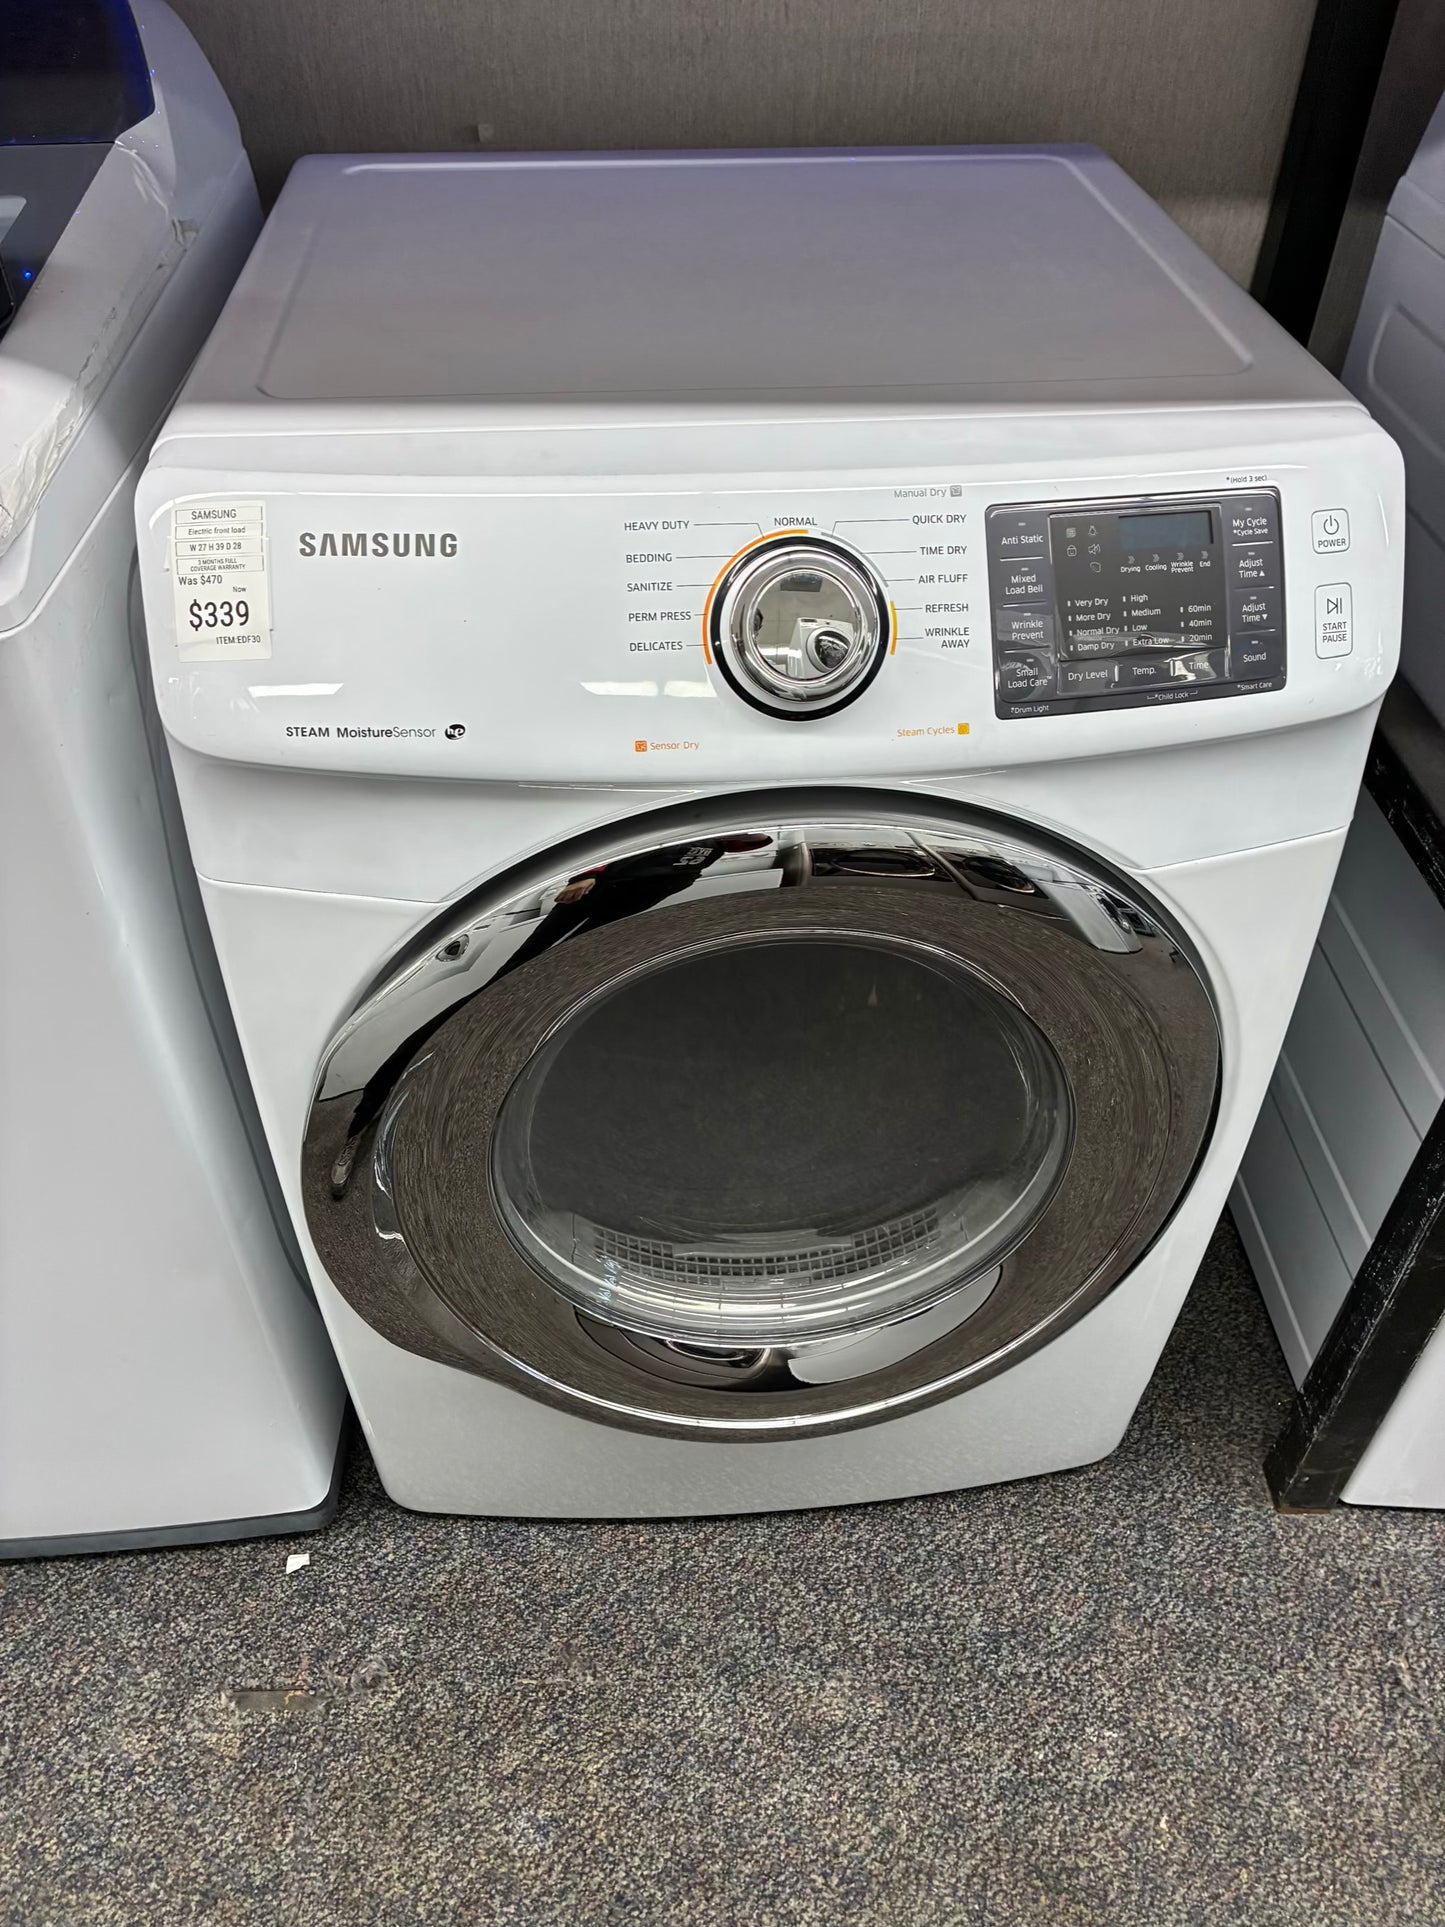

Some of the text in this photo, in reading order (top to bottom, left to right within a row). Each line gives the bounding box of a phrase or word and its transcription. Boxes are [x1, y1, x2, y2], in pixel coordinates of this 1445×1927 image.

[894, 488, 946, 498] Manual Dry
[191, 508, 237, 520] SAMSUNG
[774, 517, 818, 526] NORMAL
[912, 514, 967, 525] QUICK DRY
[1232, 517, 1267, 528] My Cycle
[624, 520, 690, 531] HEAVY DUTY
[299, 532, 458, 557] SAMSUNG
[1001, 534, 1044, 545] Anti Static
[1317, 538, 1347, 548] POWER
[920, 546, 967, 555] TIME DRY
[626, 553, 673, 563] BEDDING
[1170, 560, 1194, 568] Wrinkle
[1238, 559, 1263, 569] Adjust
[1238, 569, 1258, 578] Time
[178, 575, 223, 586] Was $470
[918, 574, 968, 584] AIR FLUFF
[1011, 574, 1036, 584] Mixed
[627, 582, 673, 592] SANITIZE
[1005, 584, 1043, 595] Load Bell
[1075, 598, 1108, 607] Very Dry
[1130, 594, 1149, 603] High
[925, 603, 969, 613] REFRESH
[1131, 608, 1161, 617] Medium
[1242, 603, 1266, 613] Adjust
[189, 599, 249, 631] $339
[628, 611, 691, 622] PERM PRESS
[1242, 613, 1261, 622] Time
[1011, 620, 1044, 629] Wrinkle
[1189, 619, 1212, 627] 40min
[1322, 621, 1347, 631] START
[925, 627, 970, 637] WRINKLE
[1012, 632, 1044, 641] Prevent
[1076, 627, 1120, 636] Normal Dry
[1133, 638, 1153, 646] Extra
[1190, 634, 1213, 642] 20min
[1322, 633, 1347, 643] PAUSE
[629, 642, 683, 652] DELICATES
[941, 639, 970, 649] AWAY
[1077, 642, 1115, 653] Damp Dry
[1243, 653, 1266, 662] Sound
[1189, 662, 1209, 670] Time
[1016, 668, 1038, 677] Small
[1068, 670, 1108, 681] Dry Level
[1132, 667, 1157, 677] Temp.
[1008, 678, 1048, 688] Load Care
[1033, 704, 1049, 712] Light
[286, 727, 330, 737] STEAM
[337, 726, 436, 738] MoistureSensor
[897, 725, 955, 737] Steam Cycles
[650, 740, 700, 751] Sensor Dry
